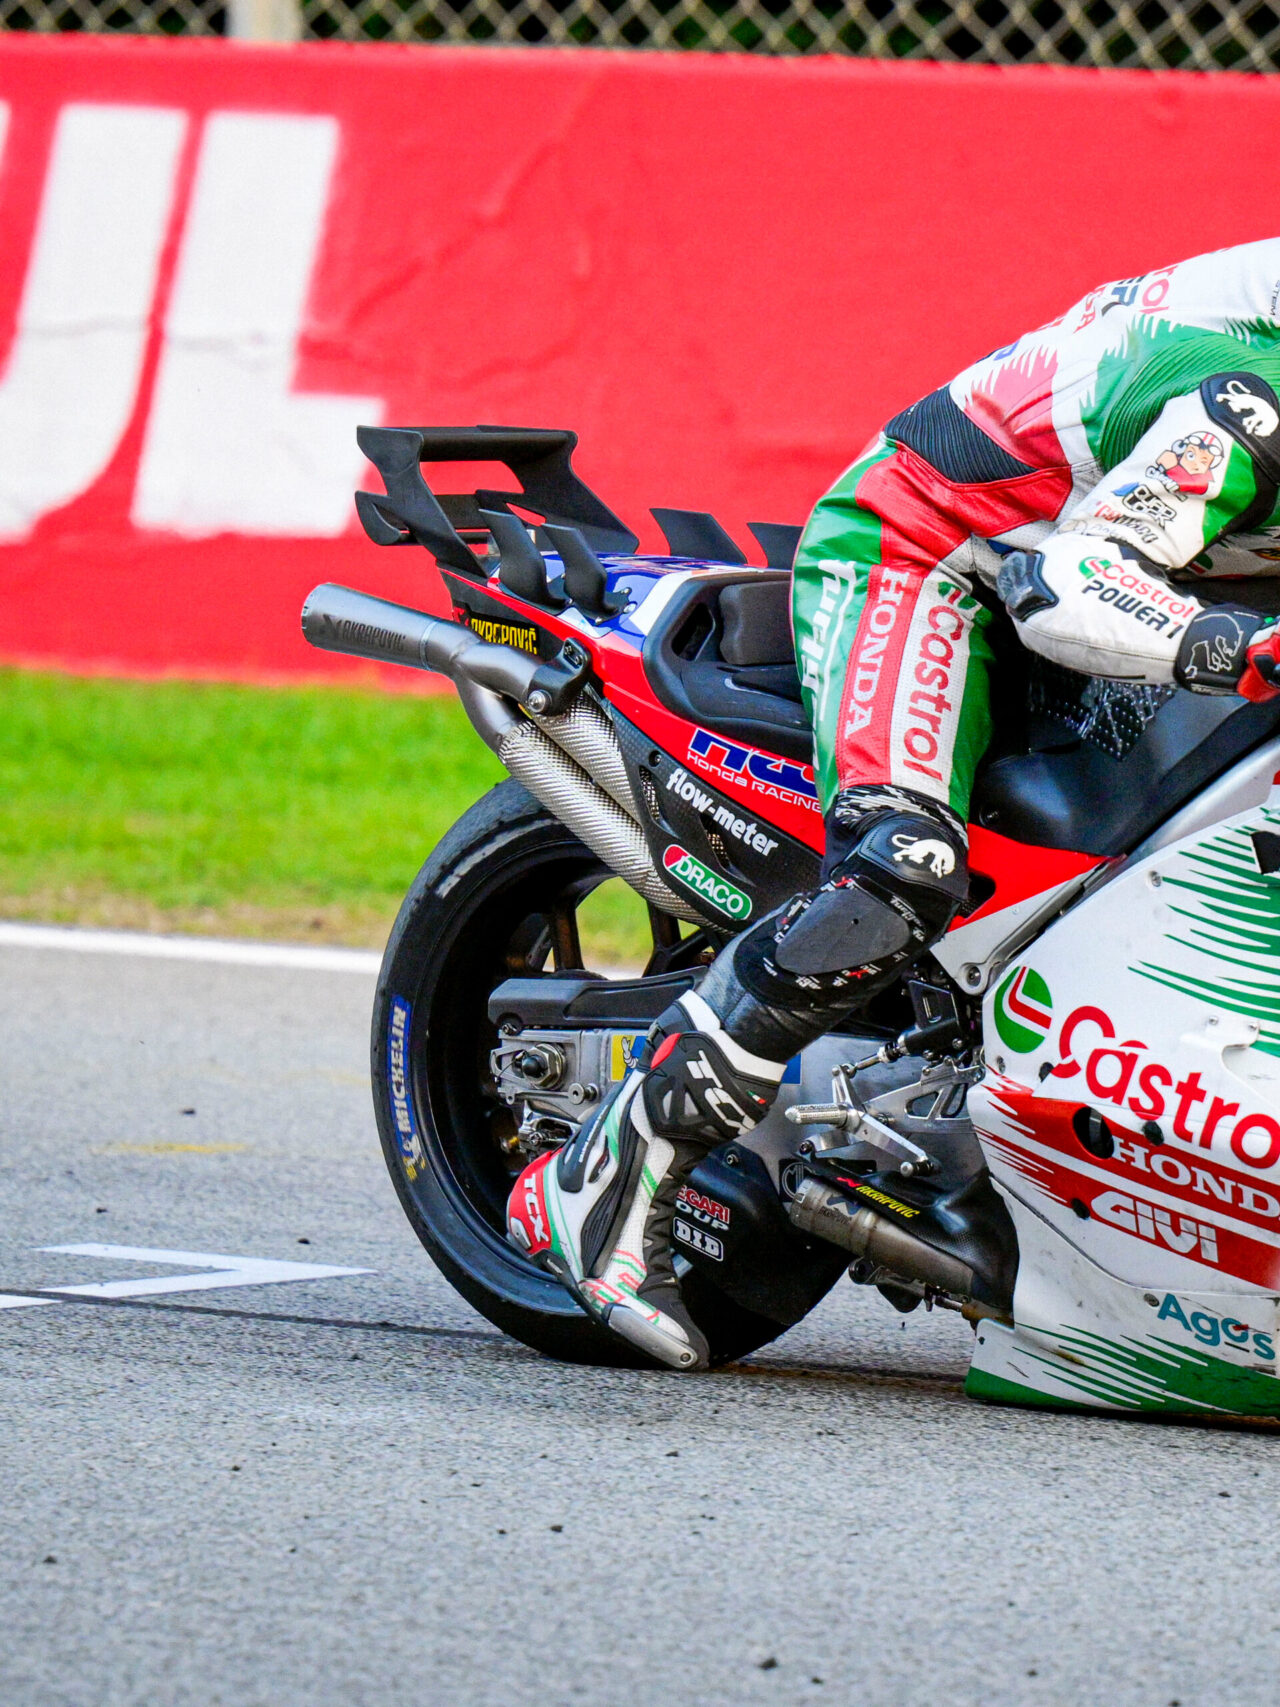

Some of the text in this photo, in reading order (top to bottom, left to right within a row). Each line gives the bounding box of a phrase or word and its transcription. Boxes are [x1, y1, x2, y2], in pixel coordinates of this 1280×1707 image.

[1102, 561, 1195, 619] Castrol
[844, 567, 910, 739] HONDA
[902, 605, 971, 782] Castrol
[687, 751, 748, 787] Honda
[666, 768, 780, 857] flow-meter
[675, 854, 744, 913] DRACO
[391, 1005, 411, 1133] MICHELIN
[524, 1173, 550, 1244] TCX
[1090, 1191, 1219, 1264] GIVI
[1157, 1293, 1276, 1361] Agos
